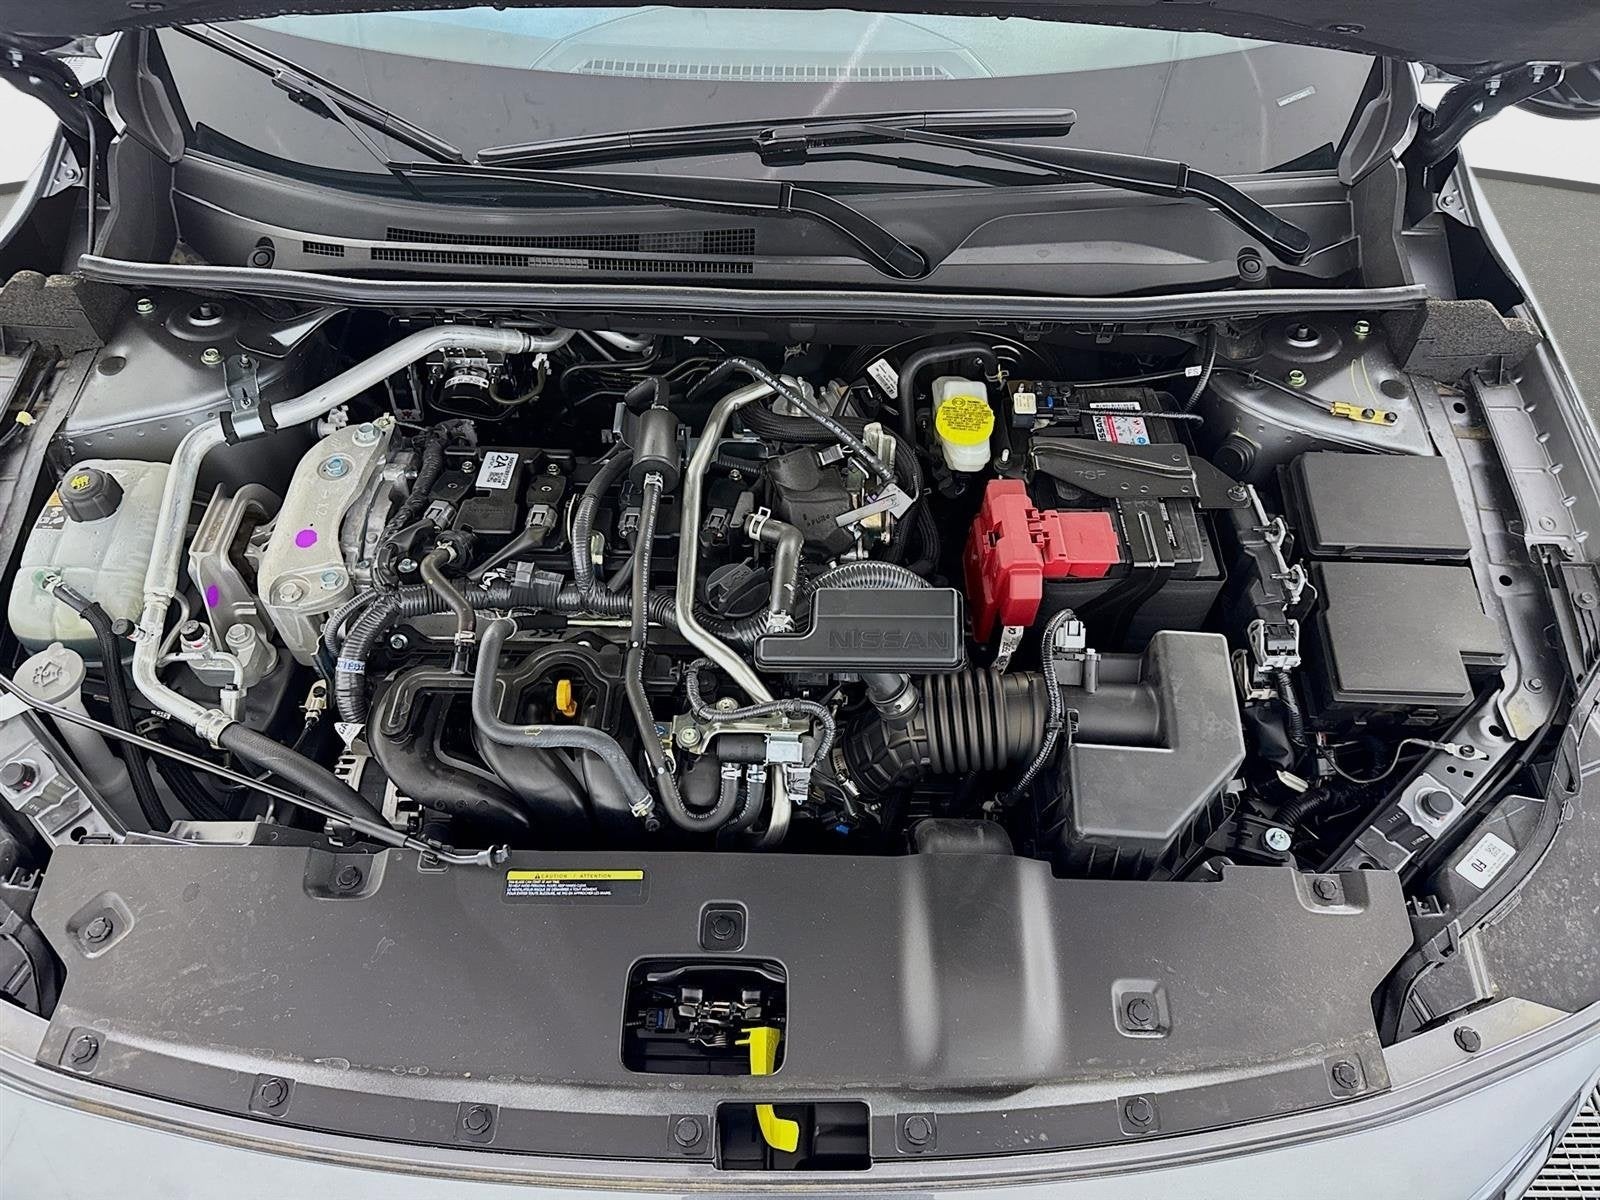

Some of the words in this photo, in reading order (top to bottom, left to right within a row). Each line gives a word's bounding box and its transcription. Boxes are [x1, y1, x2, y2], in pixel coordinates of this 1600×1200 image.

[1095, 416, 1106, 441] ISSAN
[493, 454, 509, 468] 2A
[827, 630, 950, 650] NISSAN
